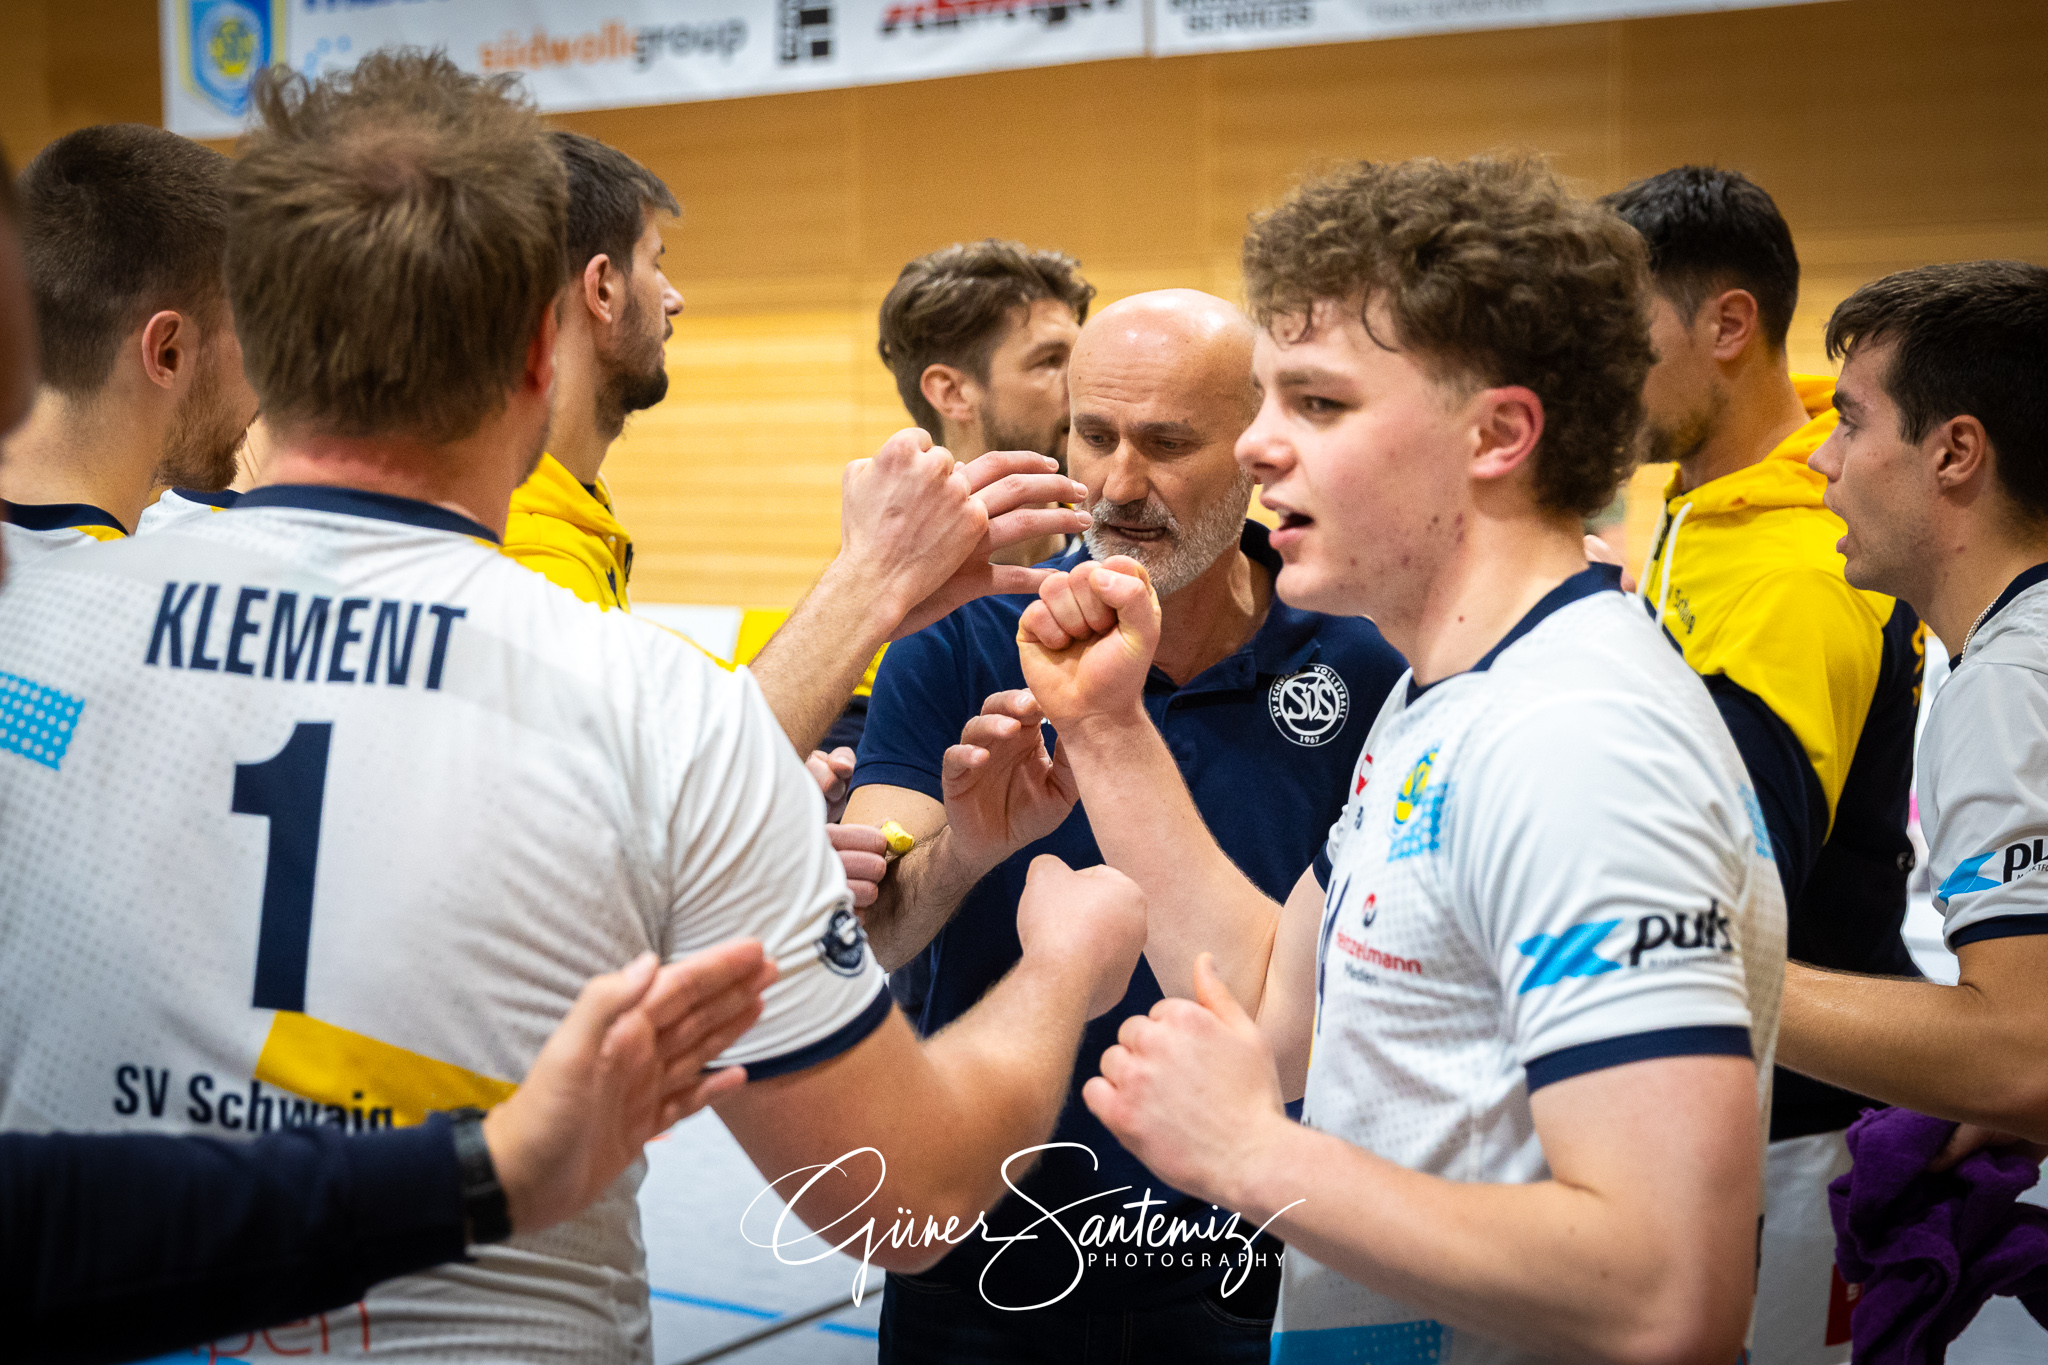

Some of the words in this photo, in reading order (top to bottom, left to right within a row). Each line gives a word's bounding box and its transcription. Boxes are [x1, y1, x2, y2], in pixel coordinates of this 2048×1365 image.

[144, 581, 467, 691] KLEMENT
[1313, 665, 1347, 719] VOLLEYBALL
[1300, 735, 1320, 744] 1967
[231, 720, 334, 1014] 1
[113, 1063, 170, 1119] SV
